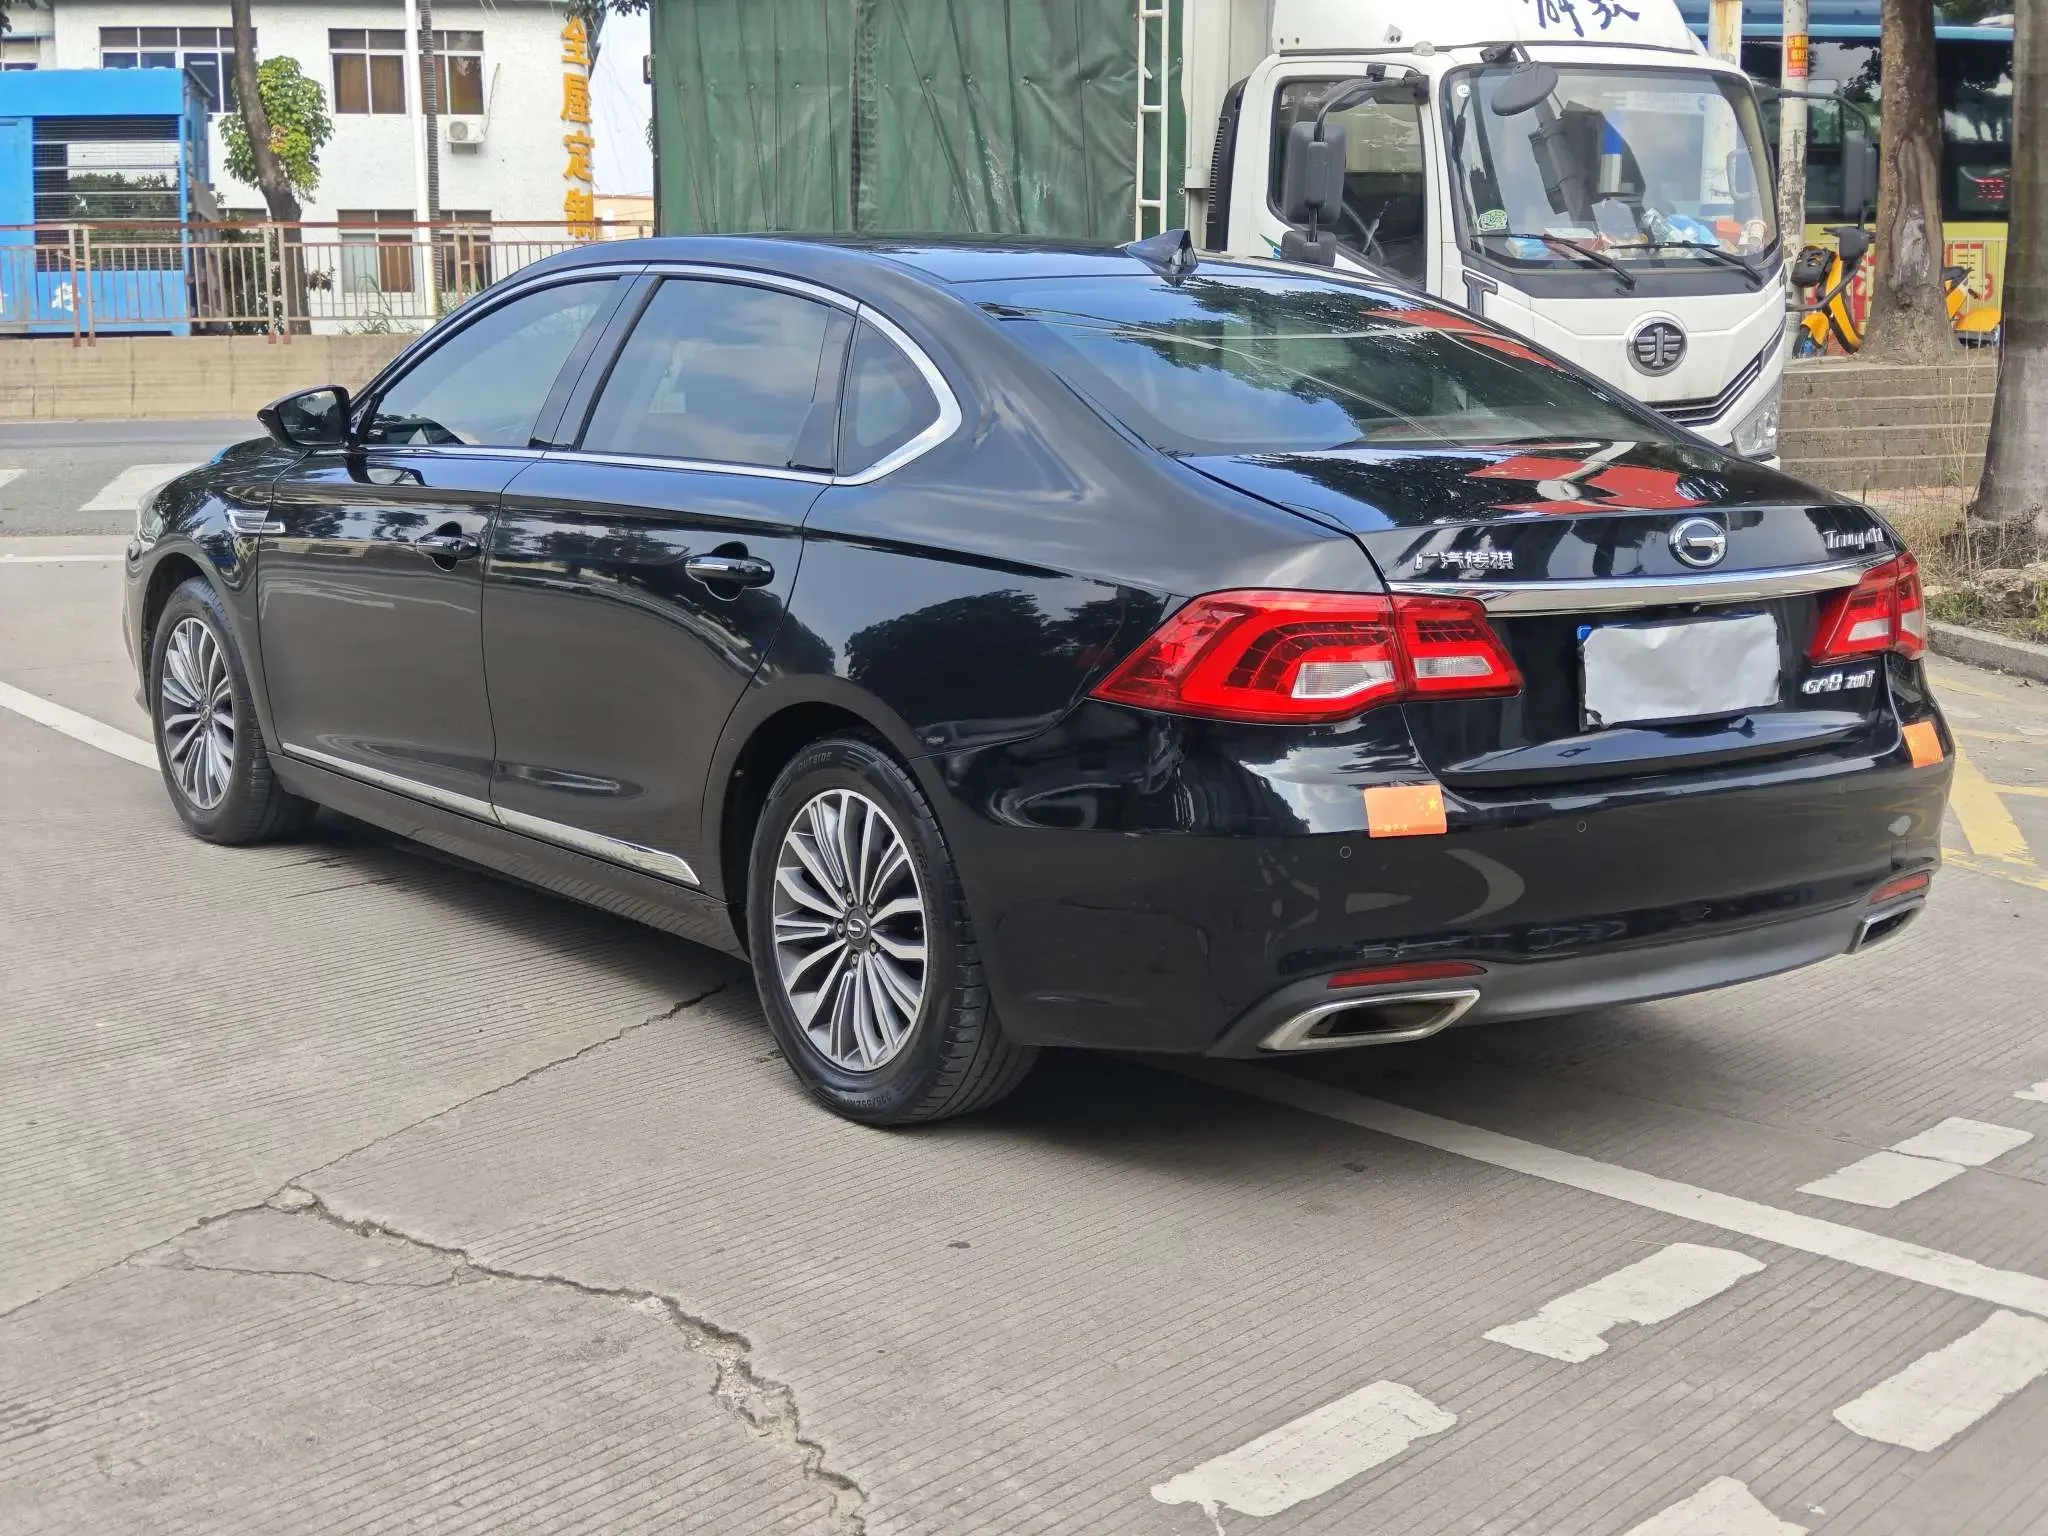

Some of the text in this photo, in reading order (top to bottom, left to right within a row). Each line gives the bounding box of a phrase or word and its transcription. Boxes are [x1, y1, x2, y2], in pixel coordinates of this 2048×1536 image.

[560, 15, 595, 240] 全屋定制
[1414, 551, 1513, 570] 广汽传祺
